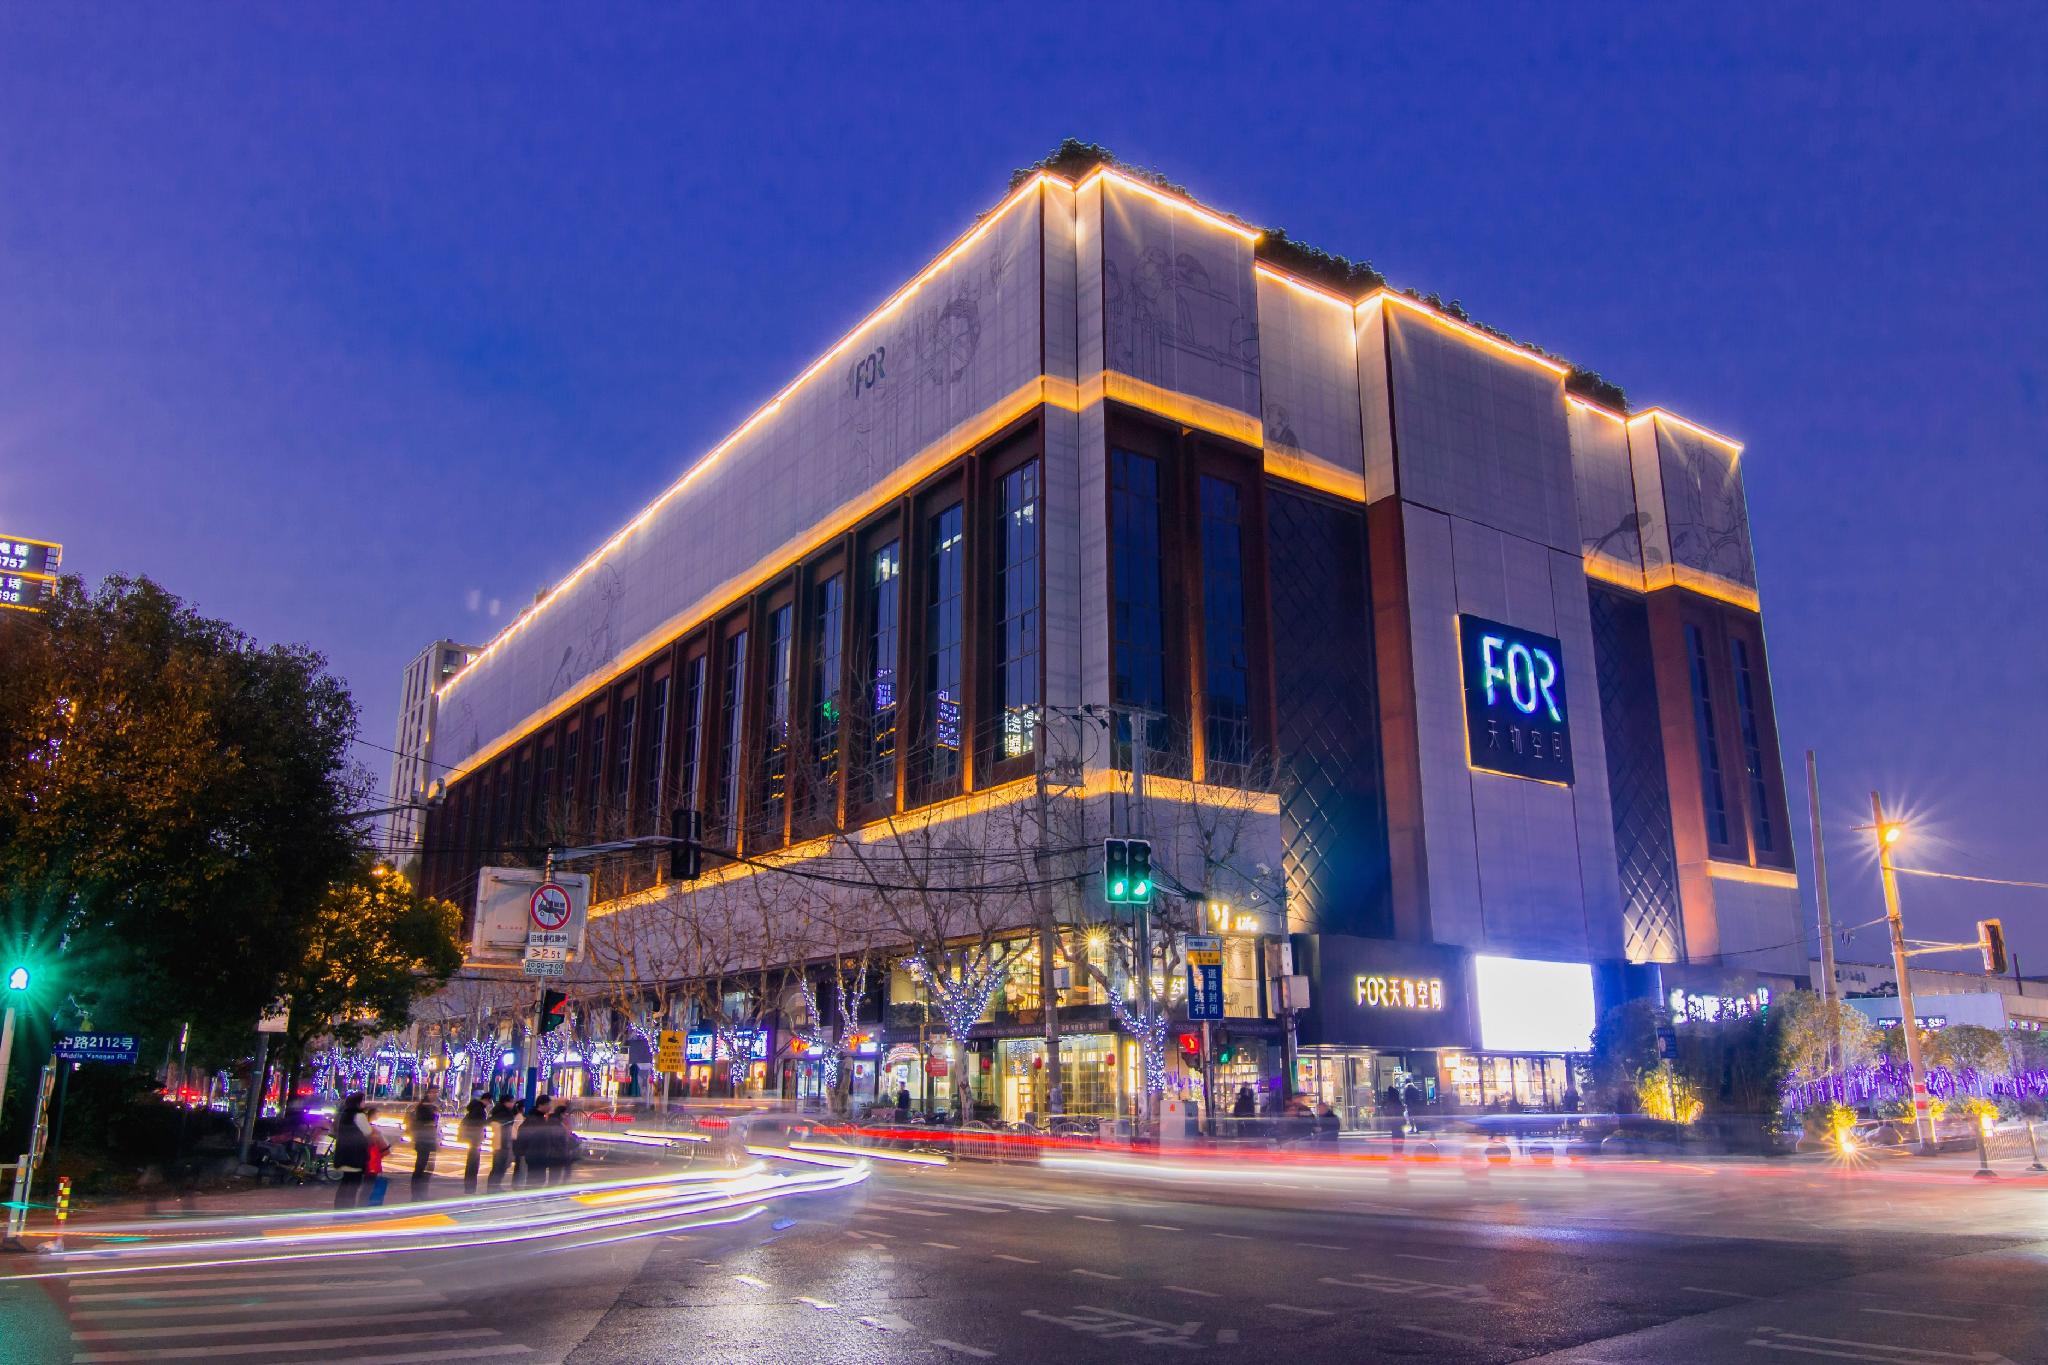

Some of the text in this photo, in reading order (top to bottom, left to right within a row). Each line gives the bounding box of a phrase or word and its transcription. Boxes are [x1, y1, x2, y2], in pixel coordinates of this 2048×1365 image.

[855, 346, 886, 399] FOR
[0, 556, 27, 569] 757
[1482, 636, 1562, 722] FOR
